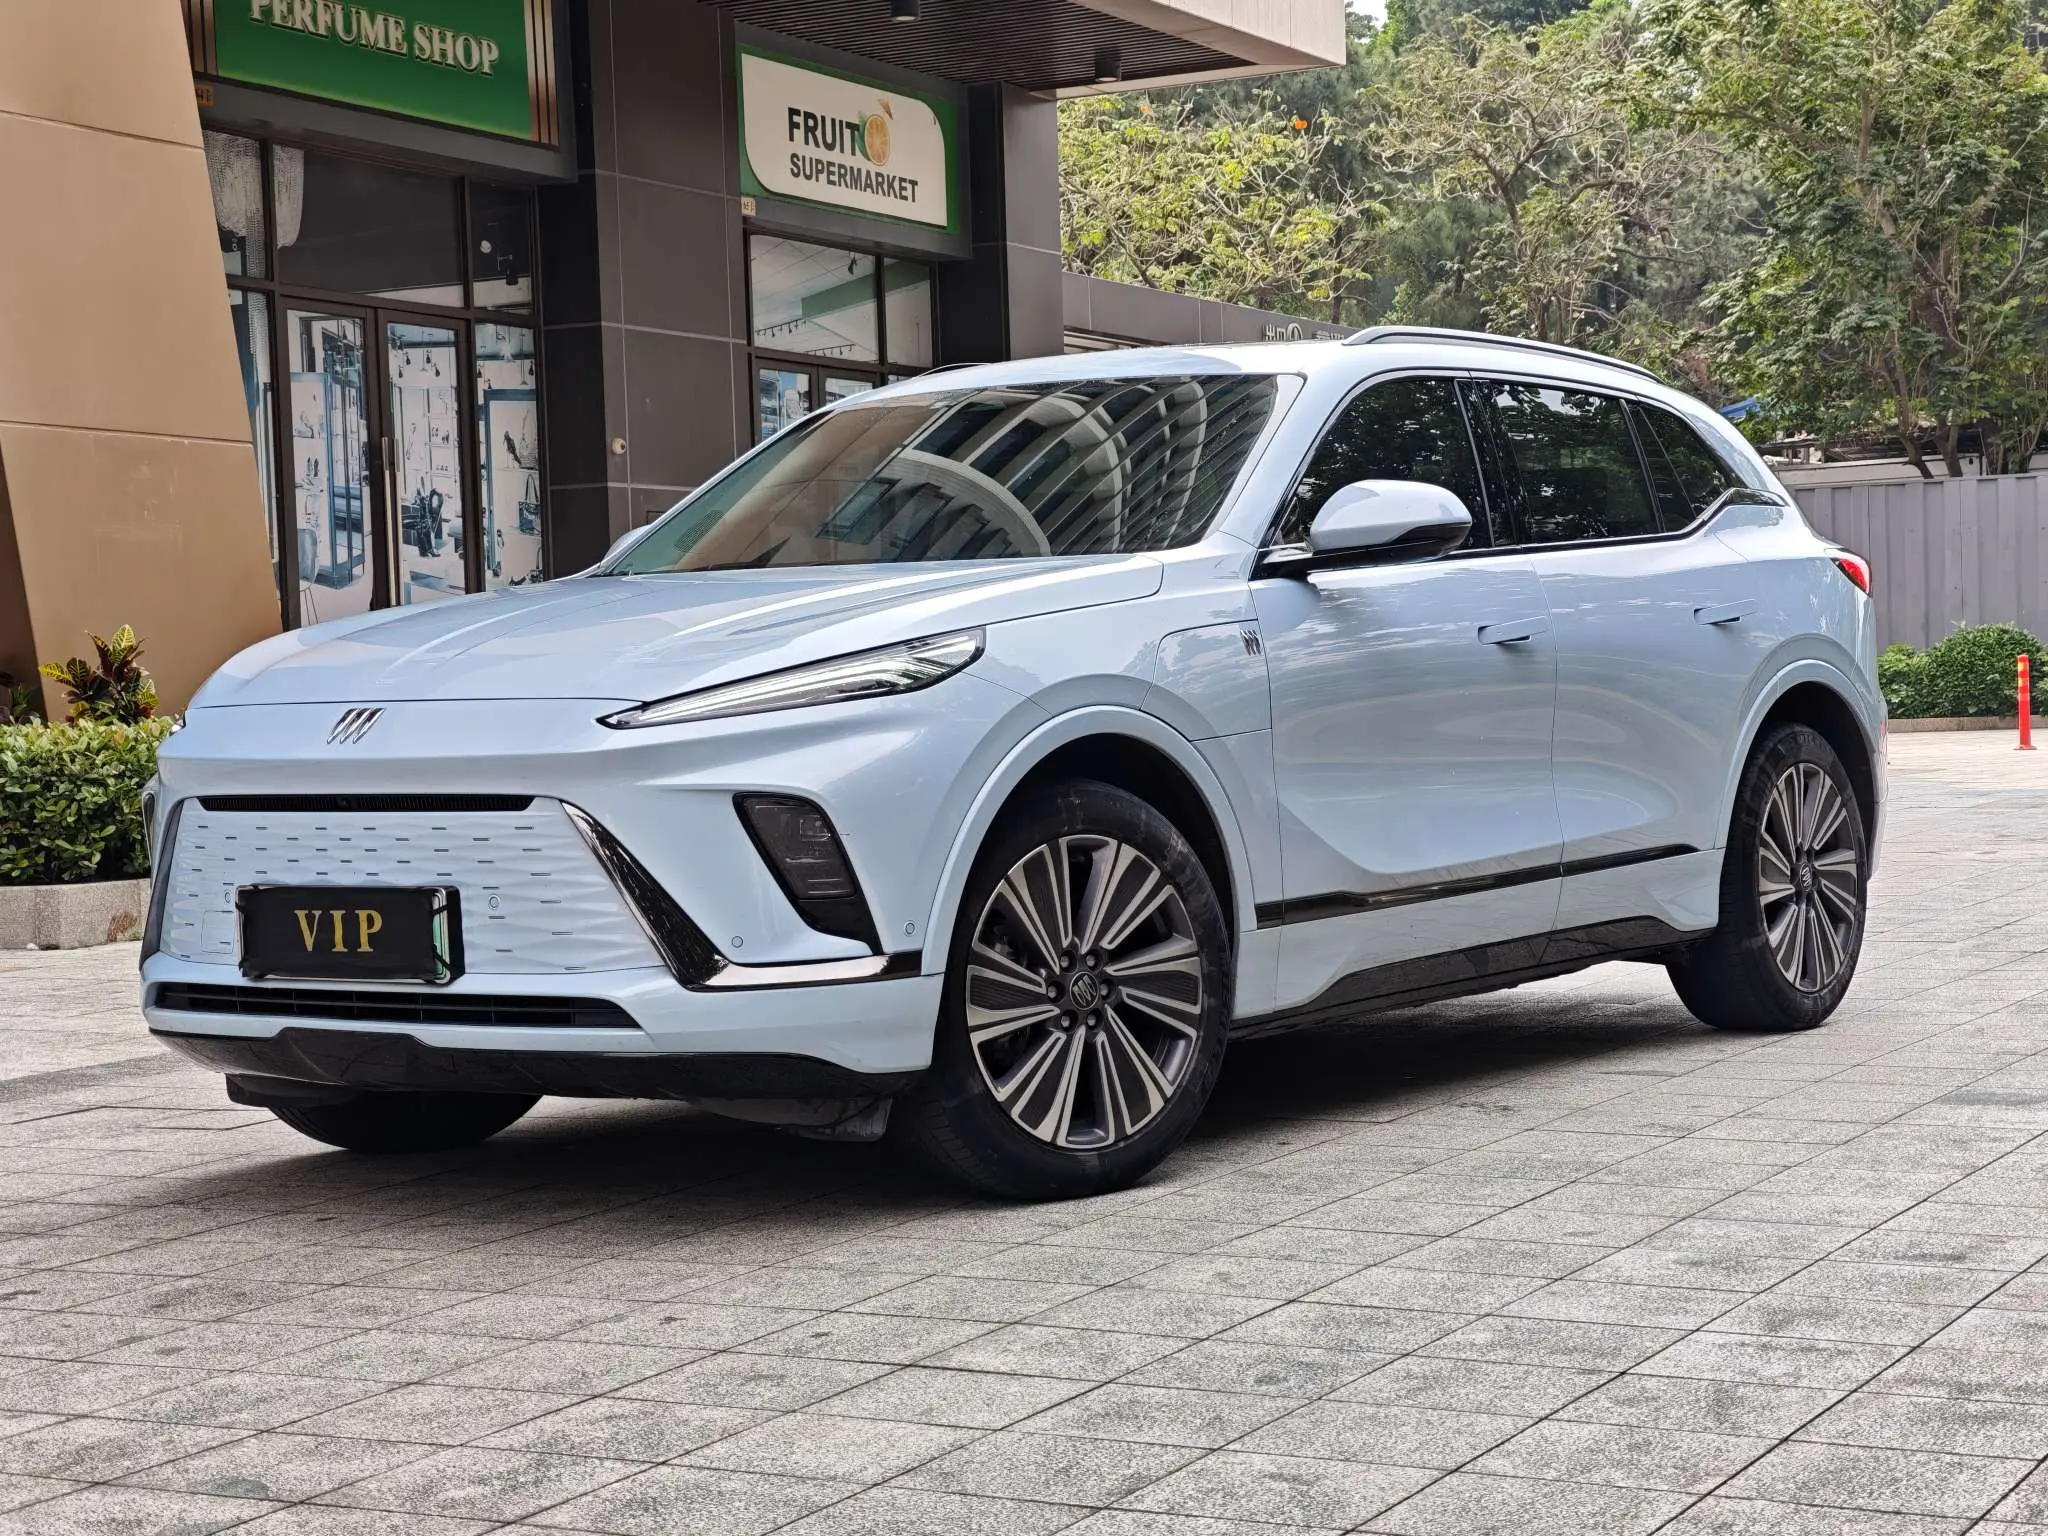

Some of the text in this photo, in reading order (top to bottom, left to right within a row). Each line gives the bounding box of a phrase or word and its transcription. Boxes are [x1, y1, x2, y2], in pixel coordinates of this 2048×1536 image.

[413, 22, 499, 76] SHOP
[787, 107, 860, 157] FRUIT
[790, 153, 918, 203] SUPERMARKET
[294, 909, 383, 953] VIP
